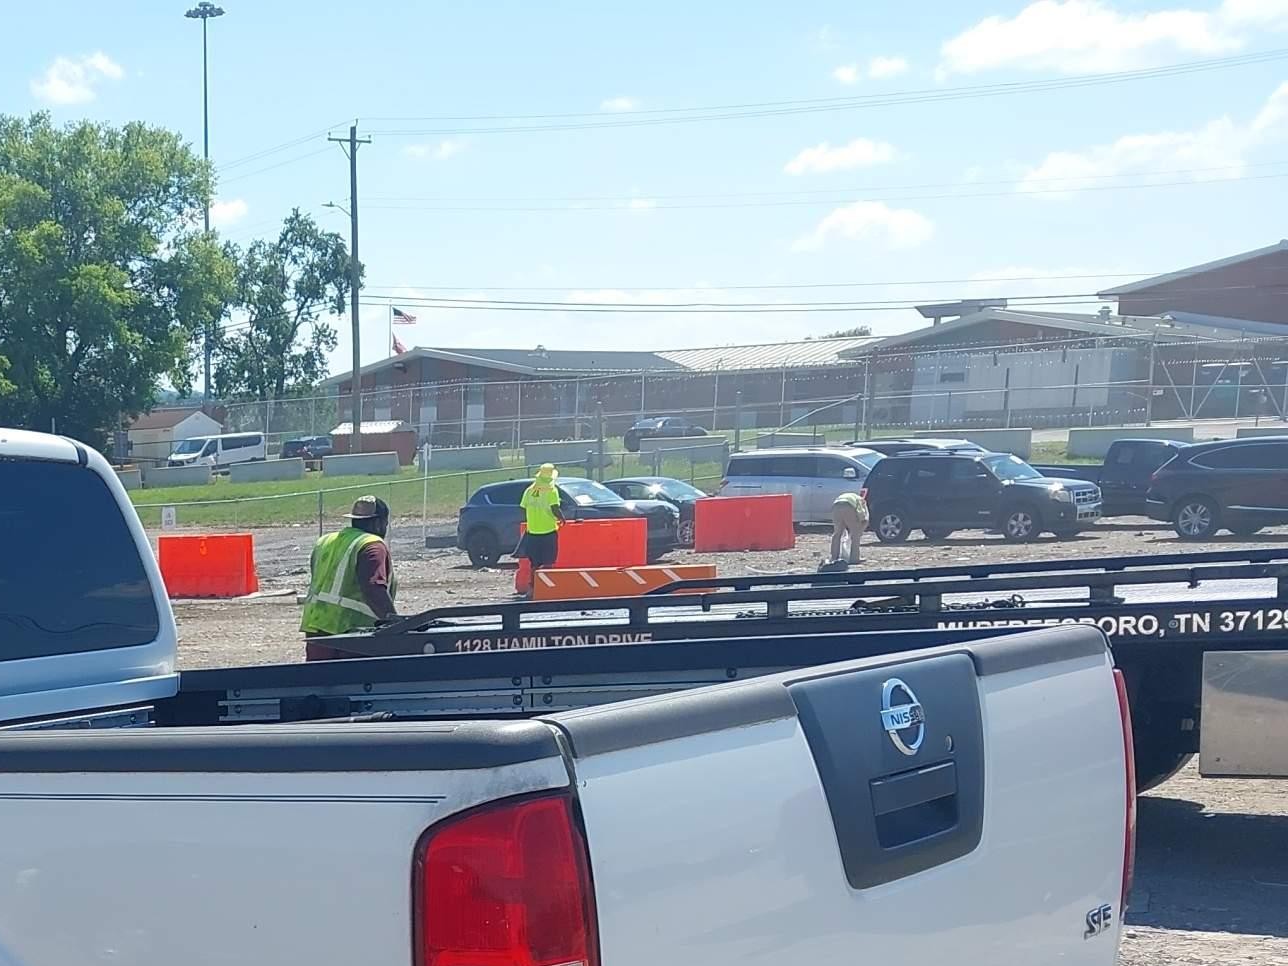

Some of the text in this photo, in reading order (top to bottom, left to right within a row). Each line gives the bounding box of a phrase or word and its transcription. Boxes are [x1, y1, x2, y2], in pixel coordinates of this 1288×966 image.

[1174, 613, 1211, 633] TN
[1219, 609, 1288, 633] 3712
[455, 639, 491, 653] 1128
[890, 707, 924, 726] NISS
[1084, 903, 1112, 940] SE
